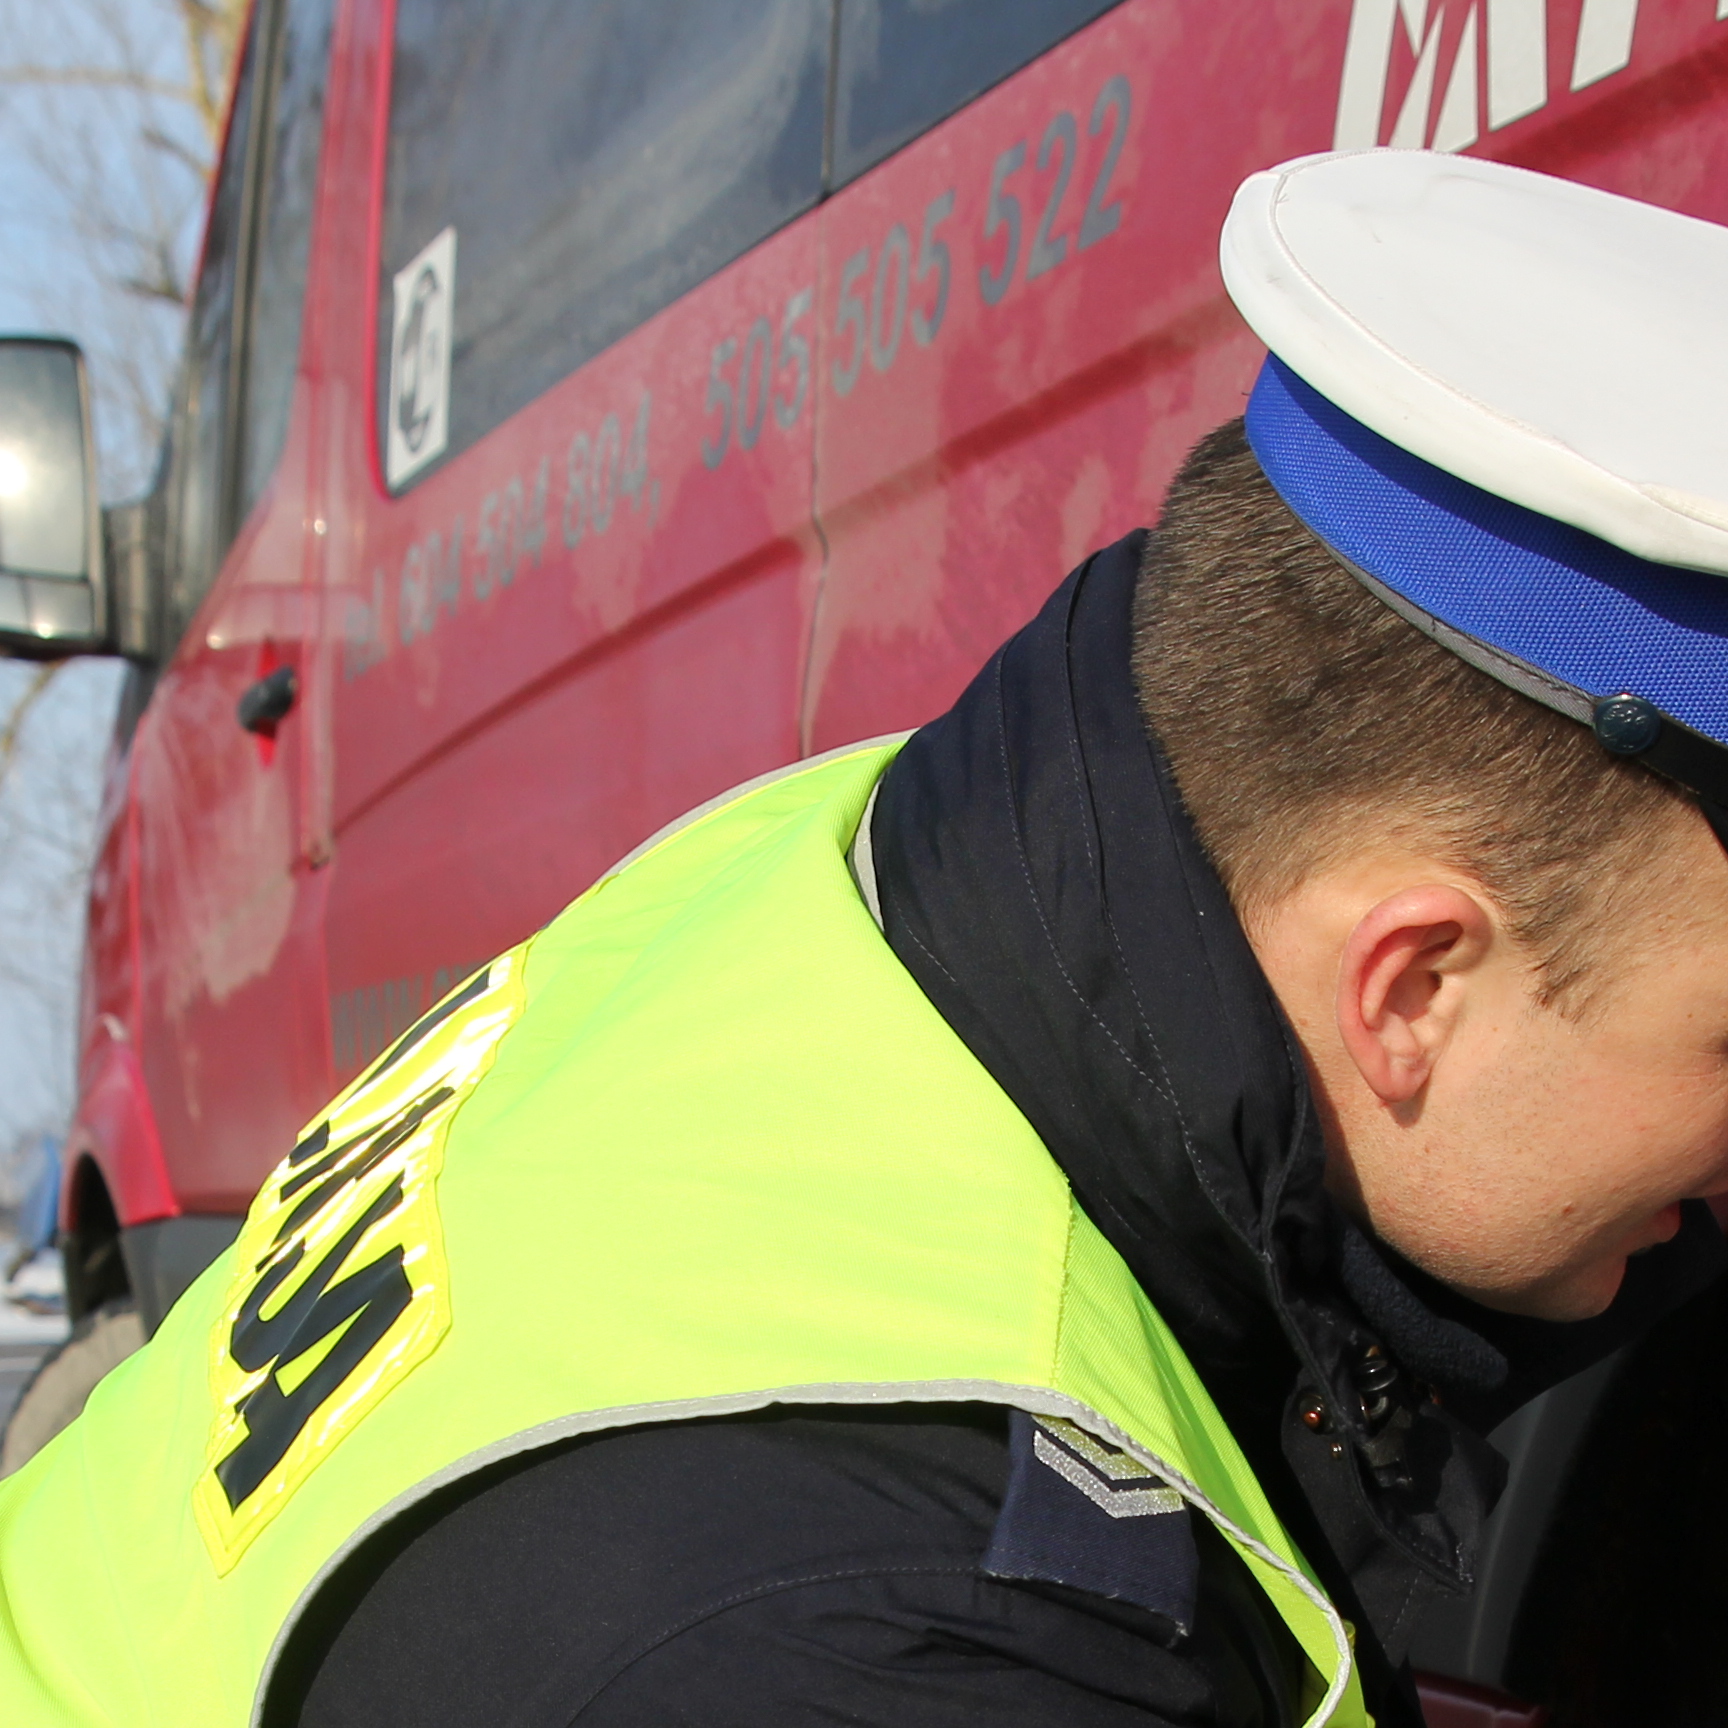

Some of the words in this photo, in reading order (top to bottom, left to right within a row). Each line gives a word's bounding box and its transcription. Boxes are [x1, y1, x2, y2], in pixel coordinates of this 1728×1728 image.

[398, 513, 465, 647] 604
[474, 455, 550, 602] 504
[701, 285, 814, 472] 505
[831, 187, 956, 398] 505
[978, 73, 1133, 308] 522
